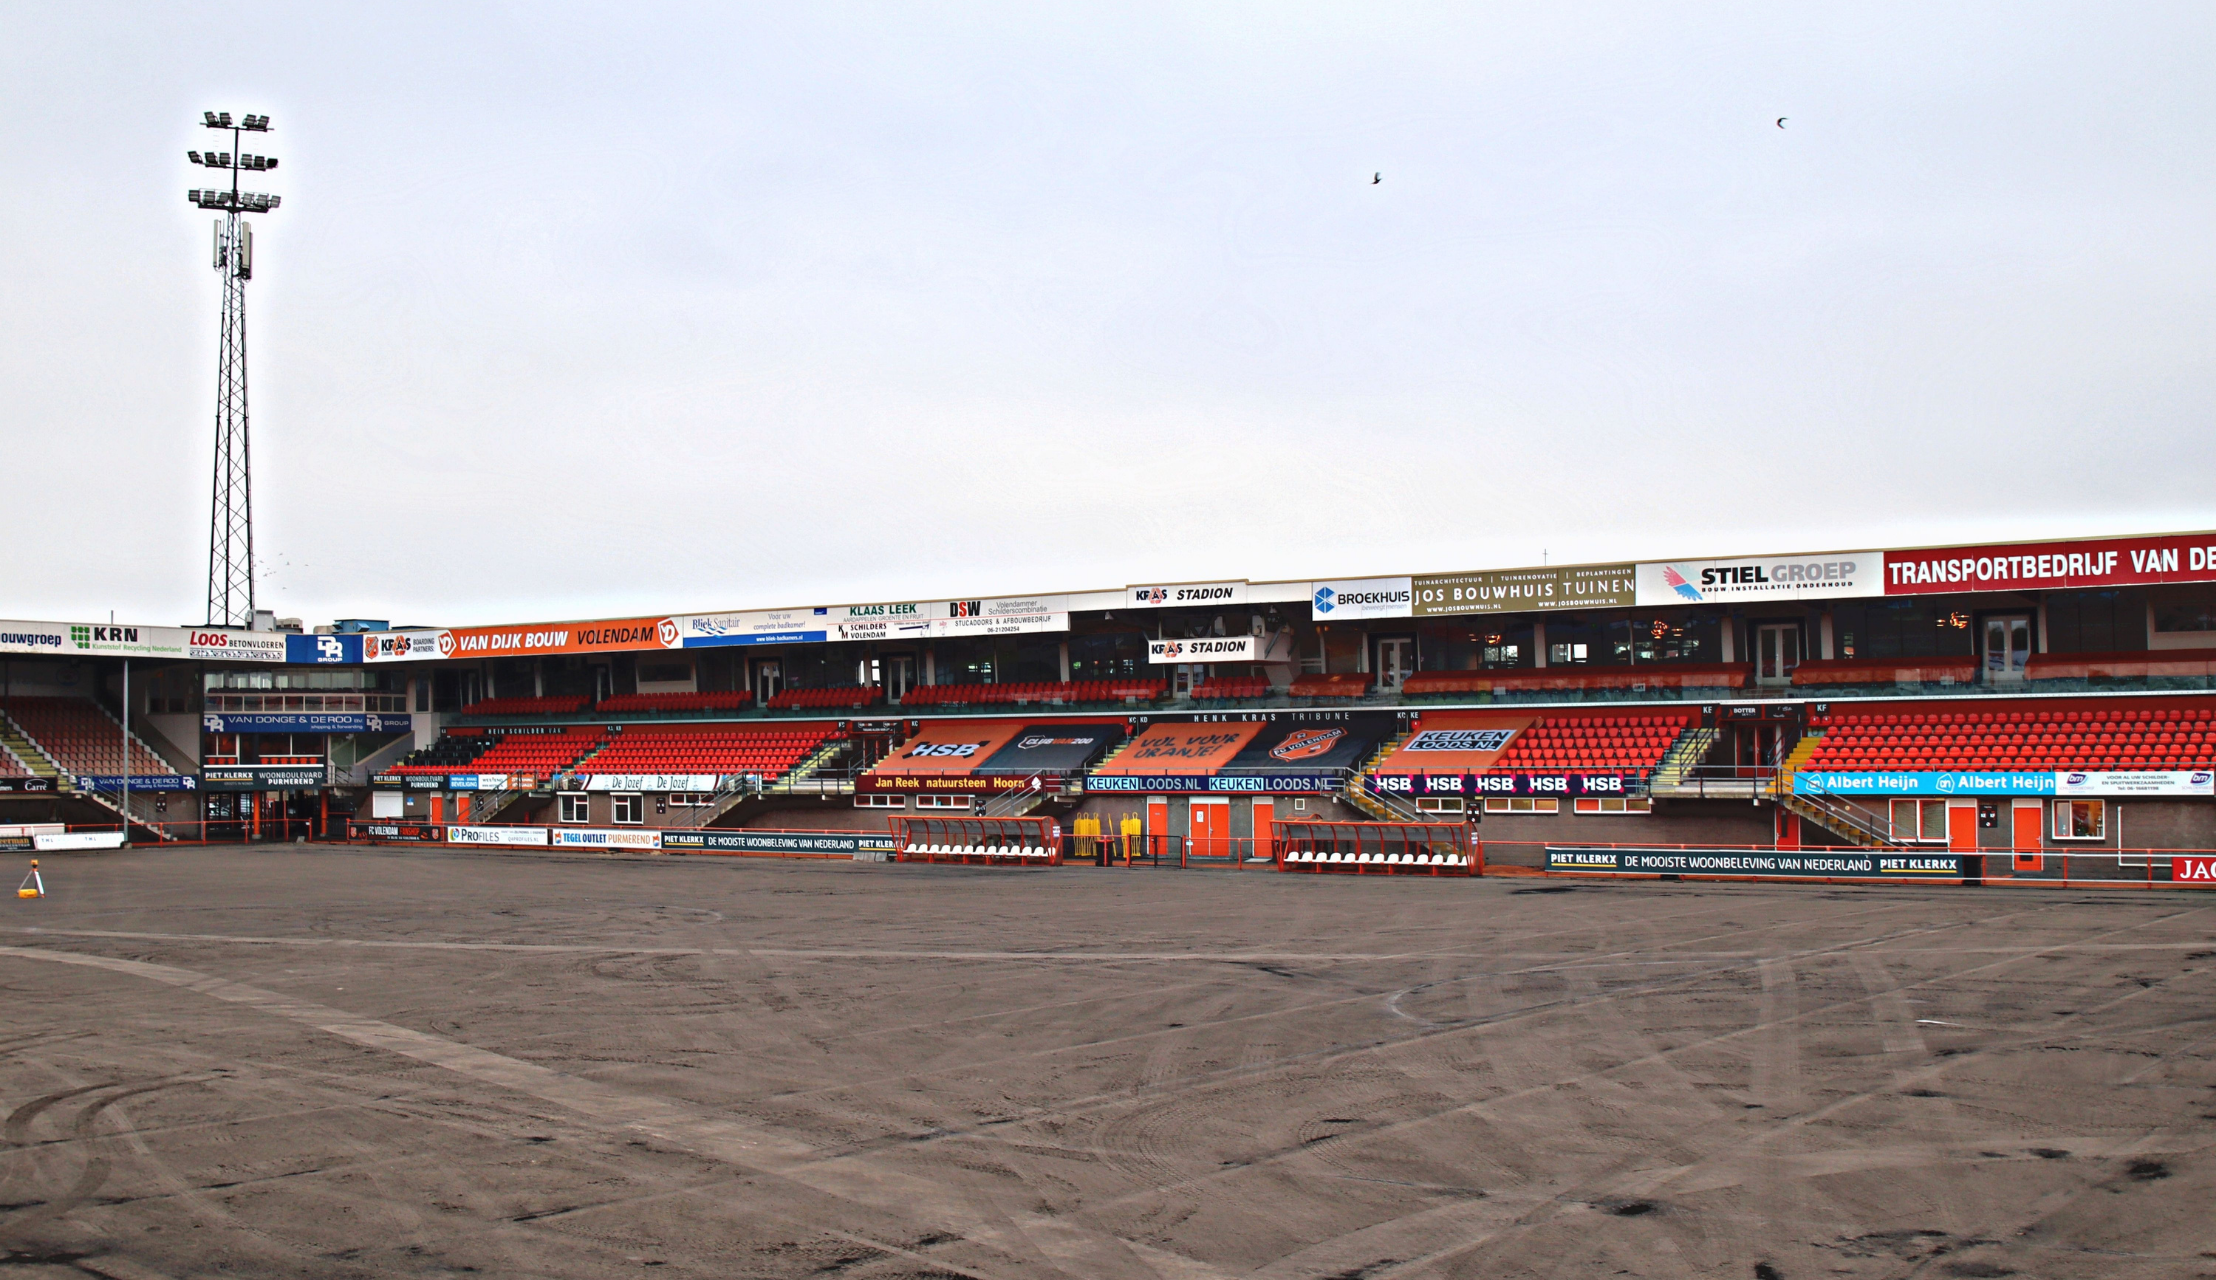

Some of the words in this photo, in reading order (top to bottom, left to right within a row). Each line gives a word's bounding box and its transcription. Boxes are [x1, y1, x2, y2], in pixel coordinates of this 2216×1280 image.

[1888, 551, 2118, 585] TRANSPORTBEDRIJF
[2130, 548, 2179, 573] VAN
[1414, 577, 1483, 587] TUINARCHITECTUUR
[1500, 573, 1558, 582] TUINRENOVATIE
[1576, 568, 1632, 578] BEPLANTINGEN
[1702, 566, 1769, 586] STIEL
[1770, 561, 1856, 582] GROEP
[1415, 588, 1444, 606] JOS
[1453, 583, 1554, 601] BOUWHUIS
[1563, 578, 1635, 596] TUINEN
[1731, 584, 1791, 592] INSTALLATIE
[1796, 581, 1853, 589] ONDERHOUD
[1176, 587, 1233, 601] STADION
[1337, 591, 1410, 605] BROEKHUIS
[996, 600, 1037, 608] Volendammer
[1427, 603, 1502, 613] WWW.JOSBOUWHUIS.NL
[1538, 598, 1617, 608] WWW.JOSBOUWHUIS.NL
[850, 606, 885, 617] KLAAS
[889, 603, 917, 615] LEEK
[949, 601, 981, 618] DSW
[843, 615, 877, 623] AARDAPPELEN
[878, 614, 901, 622] GROENTE
[1003, 615, 1052, 624] AFBOUWBEDRIJF
[753, 624, 776, 632] complete
[850, 623, 887, 632] SCHILDERS
[1, 632, 62, 648] ouwgroep
[93, 627, 138, 642] KRN
[189, 631, 228, 647] LOOS
[228, 640, 284, 650] BETONVLOEREN
[460, 635, 489, 651] VAN
[491, 633, 522, 650] DIJK
[525, 631, 569, 648] BOUW
[577, 627, 655, 645] VOLENDAM
[850, 631, 886, 640] VOLENDAM
[92, 643, 121, 651] Kunststof
[123, 644, 150, 653] Recycling
[151, 645, 182, 653] Nederland
[1190, 641, 1246, 654] STADION
[1703, 706, 1712, 714] KE
[1817, 704, 1827, 712] KF
[228, 716, 252, 724] VAN
[255, 716, 296, 724] DONGE
[298, 716, 308, 724] &
[1194, 714, 1227, 722] HENK
[1242, 713, 1276, 722] KRAS
[1291, 711, 1350, 721] TRIBUNE
[1290, 728, 1342, 750] VOLENDAM
[1420, 731, 1510, 741] KEUKEN
[911, 744, 980, 756] HSB
[1410, 740, 1500, 750] LOODS.NL
[259, 771, 322, 779] WOONBOULEVARD
[24, 782, 48, 791] Carré
[611, 777, 623, 788] De
[624, 777, 644, 790] Jozef
[656, 777, 668, 789] De
[669, 777, 690, 791] Jozef
[875, 777, 893, 788] Jan
[895, 777, 919, 788] Reek
[926, 777, 986, 788] natuursteen
[993, 777, 1025, 789] Hoorn
[1376, 777, 1412, 791] HSB
[1426, 777, 1463, 791] HSB
[1477, 777, 1514, 791] HSB
[1530, 777, 1568, 791] HSB
[1583, 777, 1622, 791] HSB
[1826, 775, 1874, 789] Albert
[1878, 775, 1919, 791] Heijn
[1958, 775, 2007, 788] Albert
[2013, 775, 2054, 791] Heijn
[375, 825, 399, 835] VOLENDAM
[562, 832, 581, 842] TEGEL
[582, 833, 606, 843] OUTLET
[607, 834, 650, 844] PURMEREND
[679, 836, 704, 844] KLERKX
[708, 836, 717, 845] DE
[718, 837, 746, 847] MOOISTE
[746, 838, 797, 848] WOONBELEVING
[798, 839, 813, 848] VAN
[814, 839, 854, 849] NEDERLAND
[859, 839, 874, 847] PIET
[1551, 853, 1573, 864] PIET
[1575, 855, 1617, 865] KLERKX
[1625, 855, 1638, 867] DE
[1641, 856, 1687, 868] MOOISTE
[1688, 857, 1776, 869] WOONBELEVING
[1777, 858, 1801, 869] VAN
[1804, 859, 1872, 871] NEDERLAND
[1880, 858, 1907, 869] PIET
[1909, 859, 1957, 870] KLERKX
